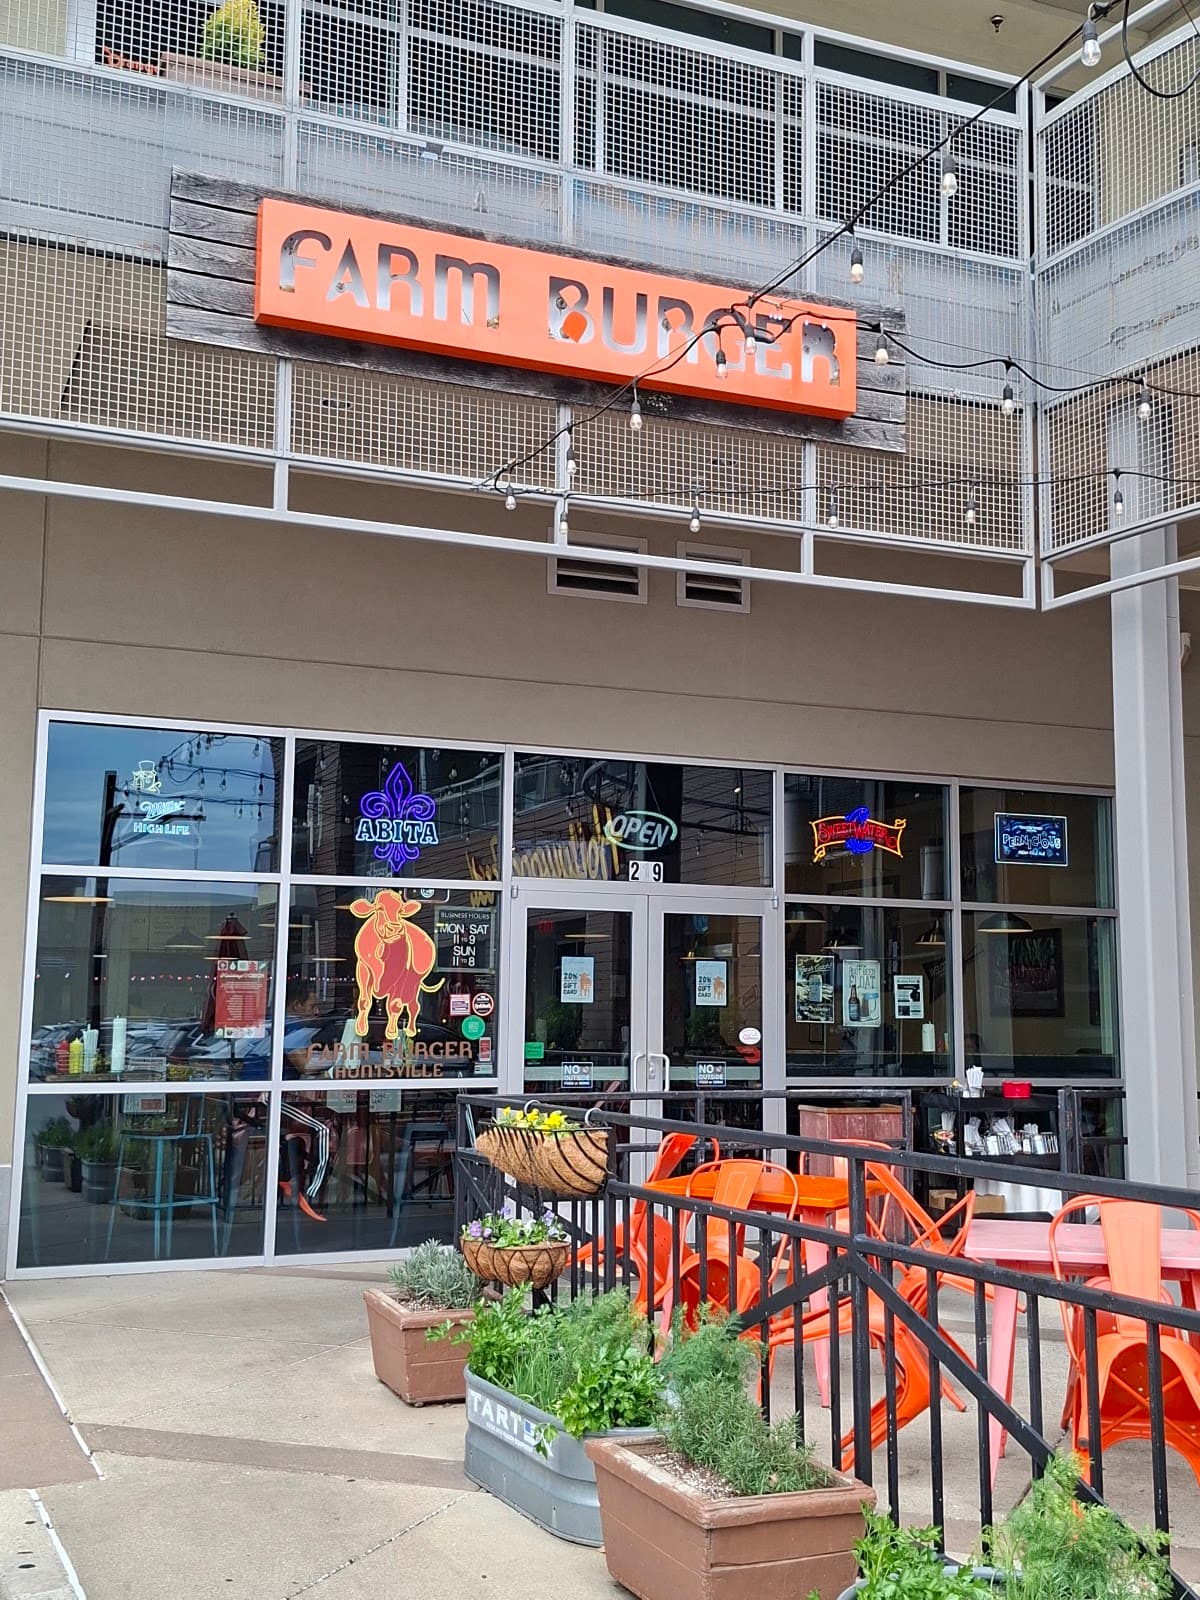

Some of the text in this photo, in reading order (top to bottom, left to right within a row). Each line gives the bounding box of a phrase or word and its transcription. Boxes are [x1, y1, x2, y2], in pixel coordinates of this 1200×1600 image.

[279, 229, 840, 388] FARM BURGER
[133, 822, 190, 835] HIGH LIFE
[355, 818, 439, 845] ABITA
[610, 815, 670, 848] OPEN
[1002, 833, 1062, 850] PERNICIOUS
[440, 912, 468, 920] BUSINESS
[439, 922, 490, 935] MON SAT
[469, 934, 476, 945] 9
[453, 945, 476, 957] SUN
[468, 956, 476, 967] 8
[382, 1041, 473, 1060] BURGER
[335, 1063, 444, 1079] HUNTSVILLE
[564, 1064, 581, 1075] NO
[698, 1064, 714, 1074] NO
